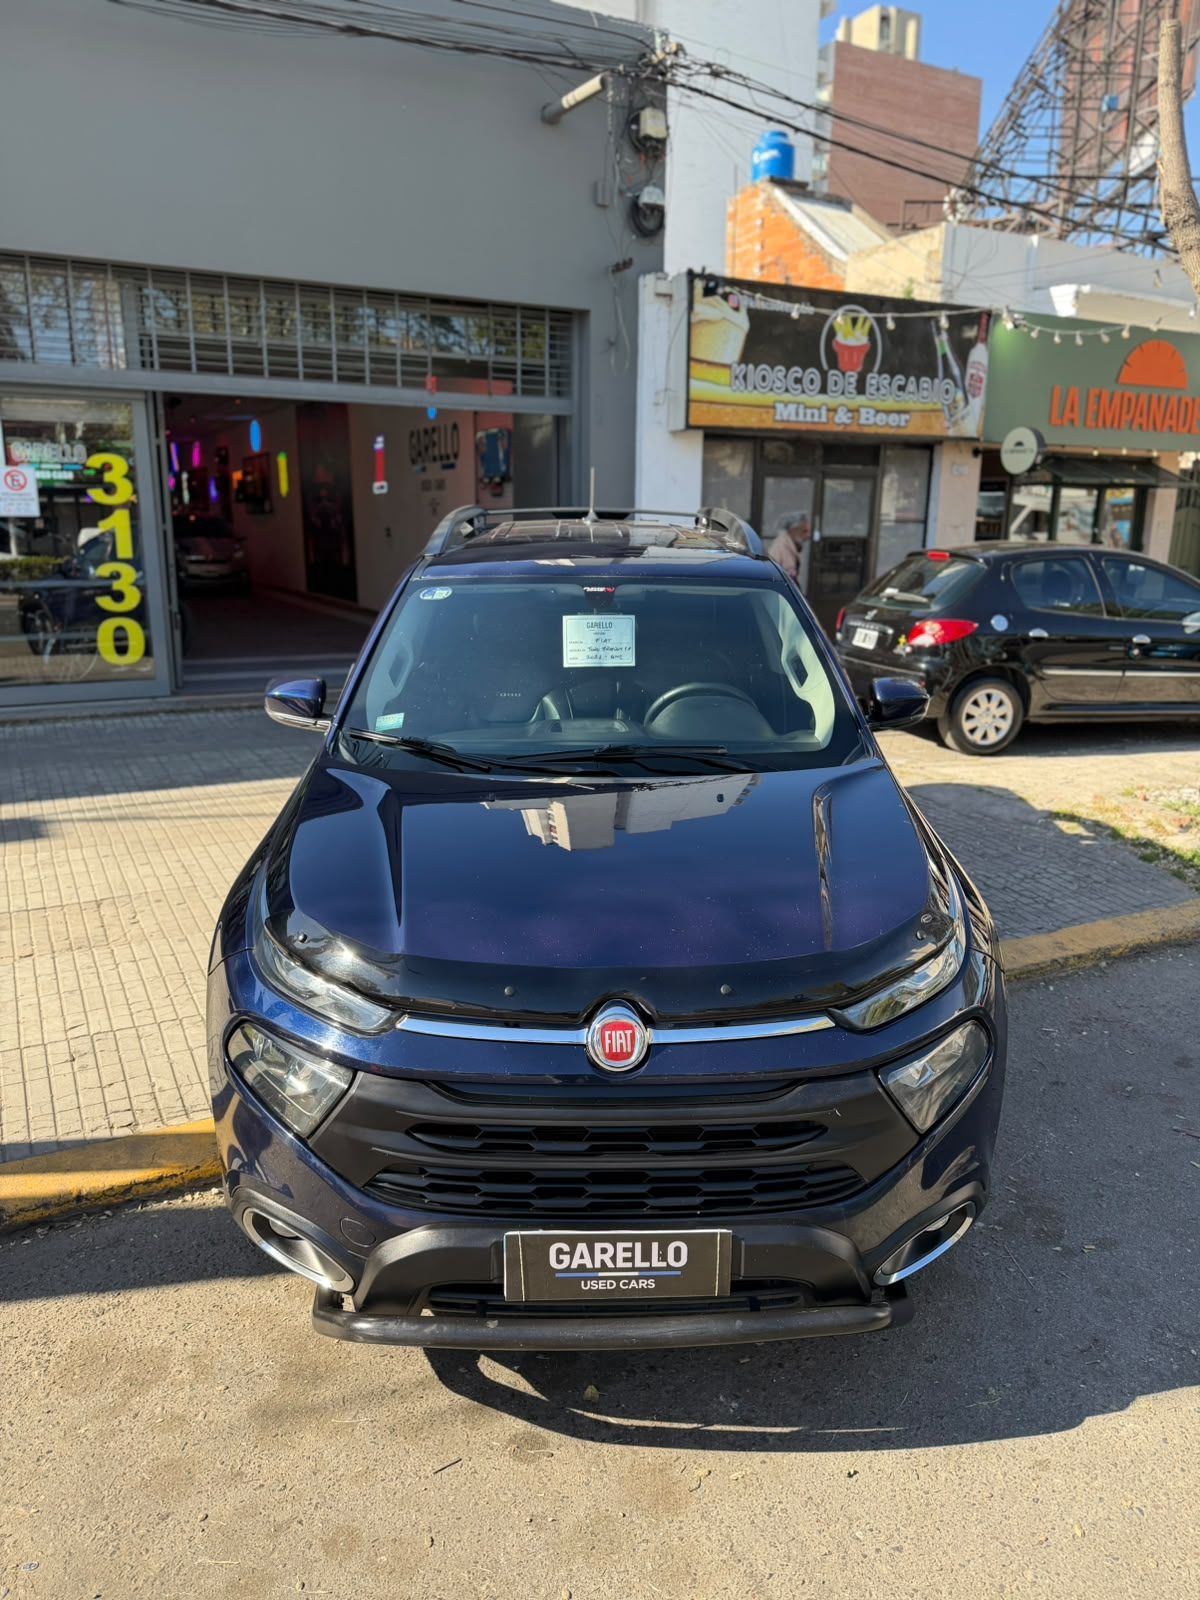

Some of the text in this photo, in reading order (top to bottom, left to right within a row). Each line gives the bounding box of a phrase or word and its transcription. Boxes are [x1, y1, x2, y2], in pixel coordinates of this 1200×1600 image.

[731, 363, 822, 396] KIOSCO
[827, 369, 857, 398] DE
[865, 373, 956, 404] ESCABIO
[774, 402, 911, 428] Mini & Beer
[1050, 384, 1081, 428] LA
[85, 452, 146, 666] 3130
[605, 1030, 633, 1053] FIAT
[549, 1241, 688, 1270] GARELLO
[581, 1279, 656, 1290] USED CARS
